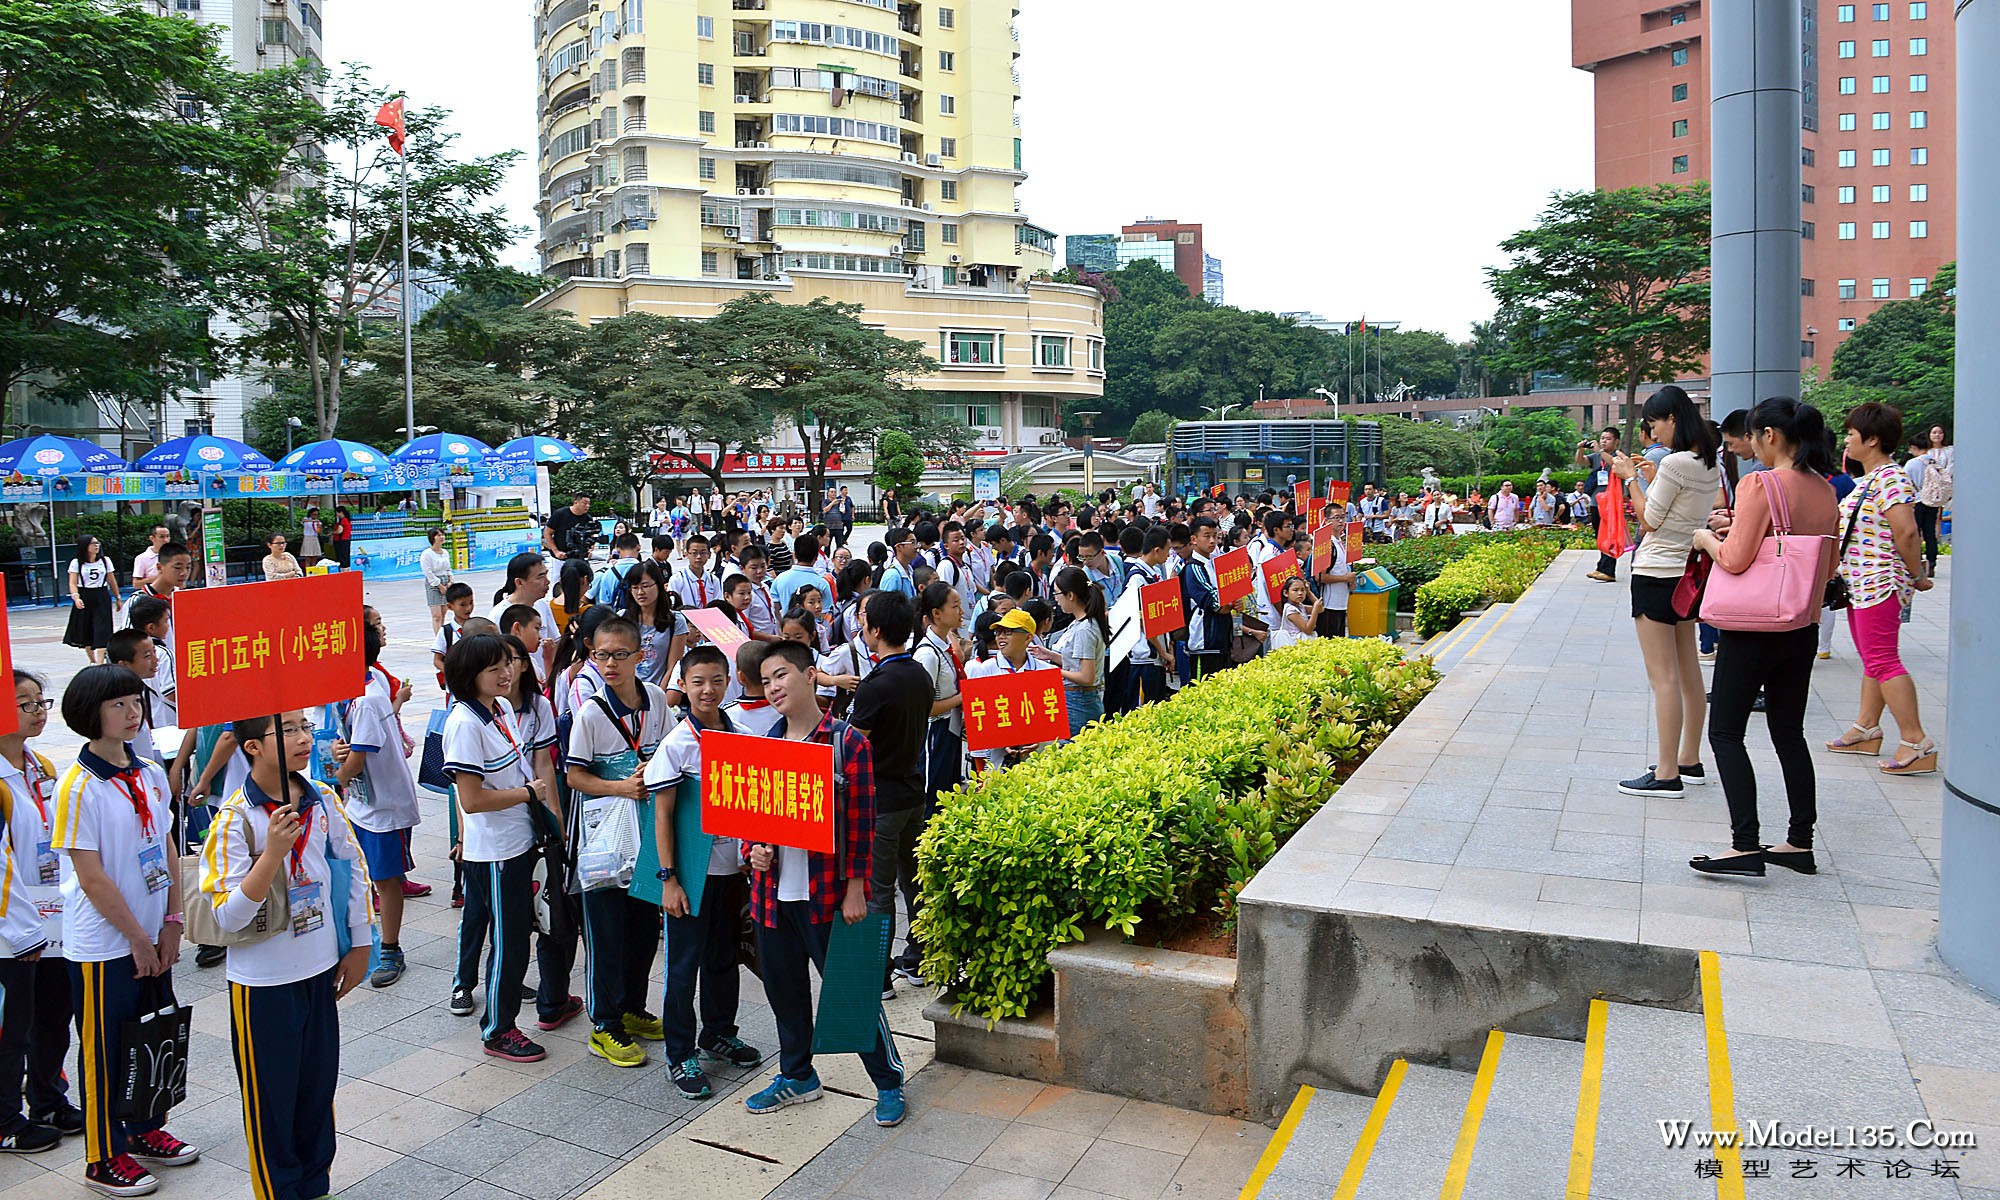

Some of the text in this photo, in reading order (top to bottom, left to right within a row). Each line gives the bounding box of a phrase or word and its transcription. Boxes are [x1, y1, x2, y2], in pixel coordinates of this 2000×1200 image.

[89, 569, 100, 581] 5
[1269, 563, 1299, 589] 灌口中学
[1147, 596, 1180, 621] 厦门一中
[970, 688, 1060, 732] 宁宝小学
[708, 760, 825, 824] 北师大海沧附属学校
